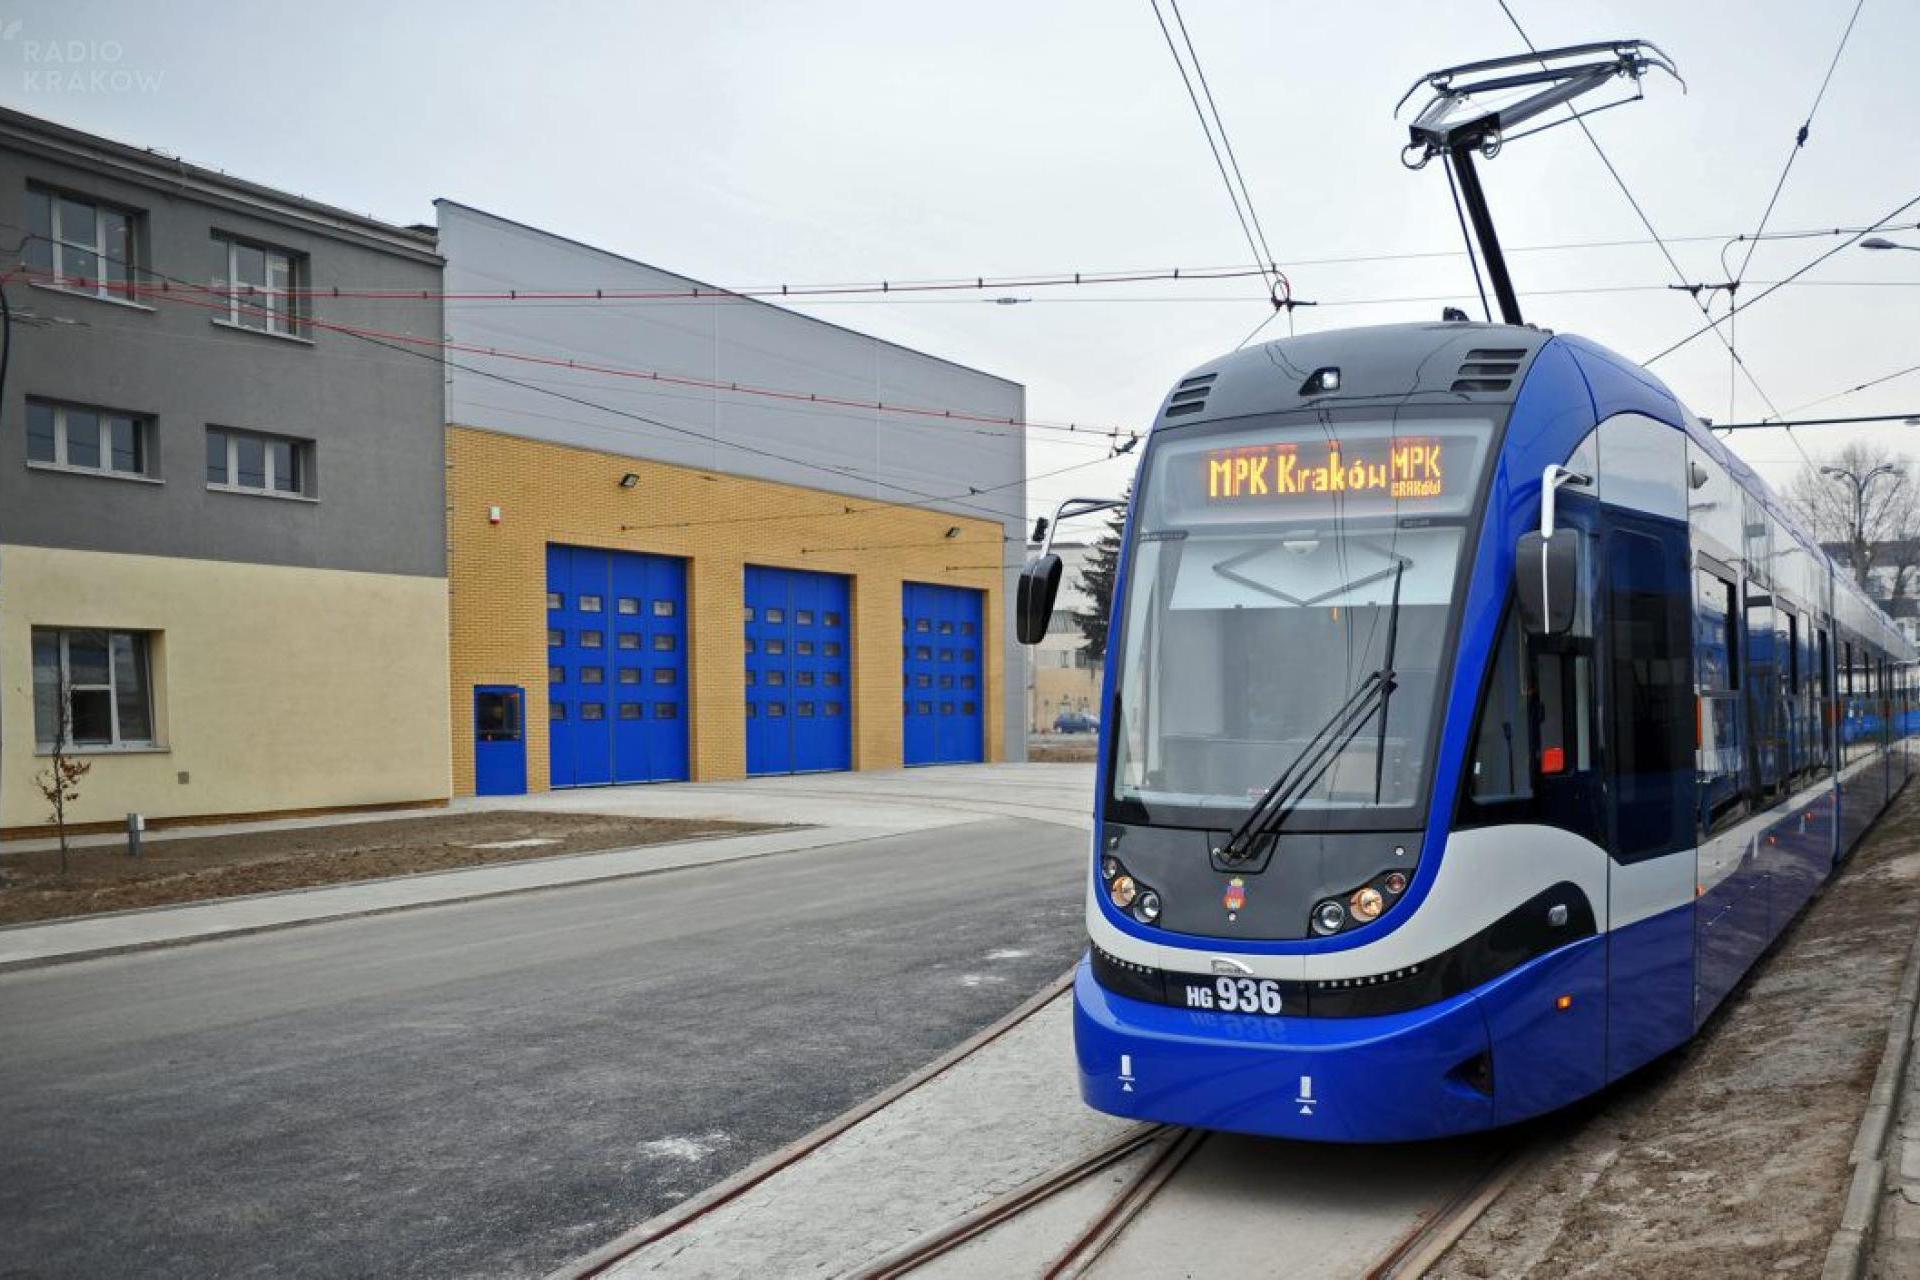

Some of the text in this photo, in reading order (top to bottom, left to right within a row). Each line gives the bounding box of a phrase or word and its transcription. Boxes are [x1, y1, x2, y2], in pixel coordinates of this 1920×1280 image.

[1209, 451, 1387, 497] MPK Kraków
[1391, 444, 1441, 480] MPK
[1185, 976, 1282, 1015] HG 936
